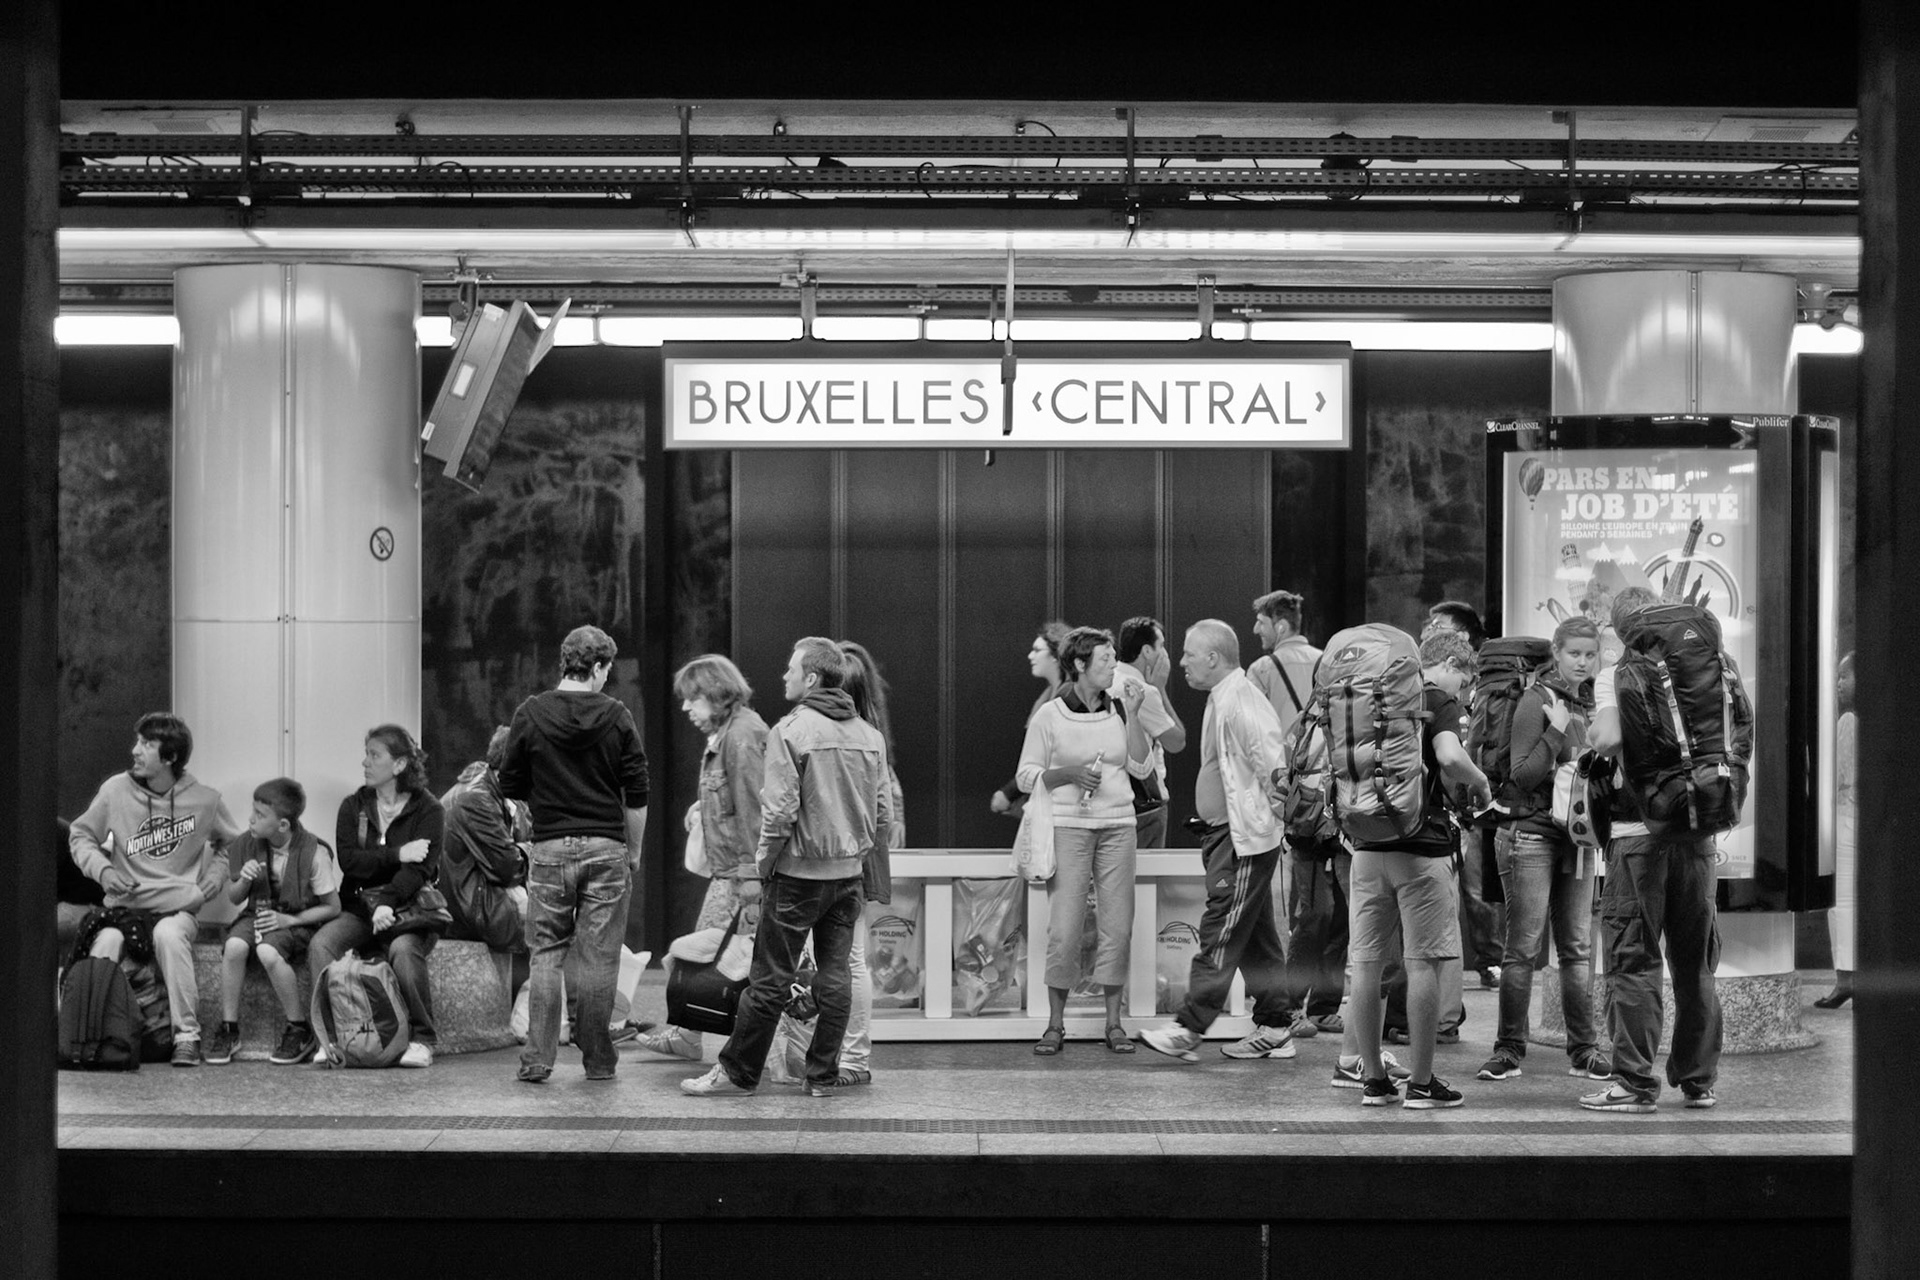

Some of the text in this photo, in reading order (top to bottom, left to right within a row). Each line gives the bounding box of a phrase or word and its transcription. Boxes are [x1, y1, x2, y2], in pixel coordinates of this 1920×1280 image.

[689, 378, 1308, 425] BRUXELLES CENTRAL
[1752, 416, 1789, 428] Publifer
[1541, 466, 1659, 491] PARS EN
[1560, 484, 1738, 521] JOB D’ÉTÉ
[1560, 522, 1600, 531] SILLONNE
[1645, 522, 1659, 531] EN
[1560, 531, 1598, 539] PENDANT
[1607, 530, 1653, 539] SEMAINES
[879, 930, 907, 938] HOLDING
